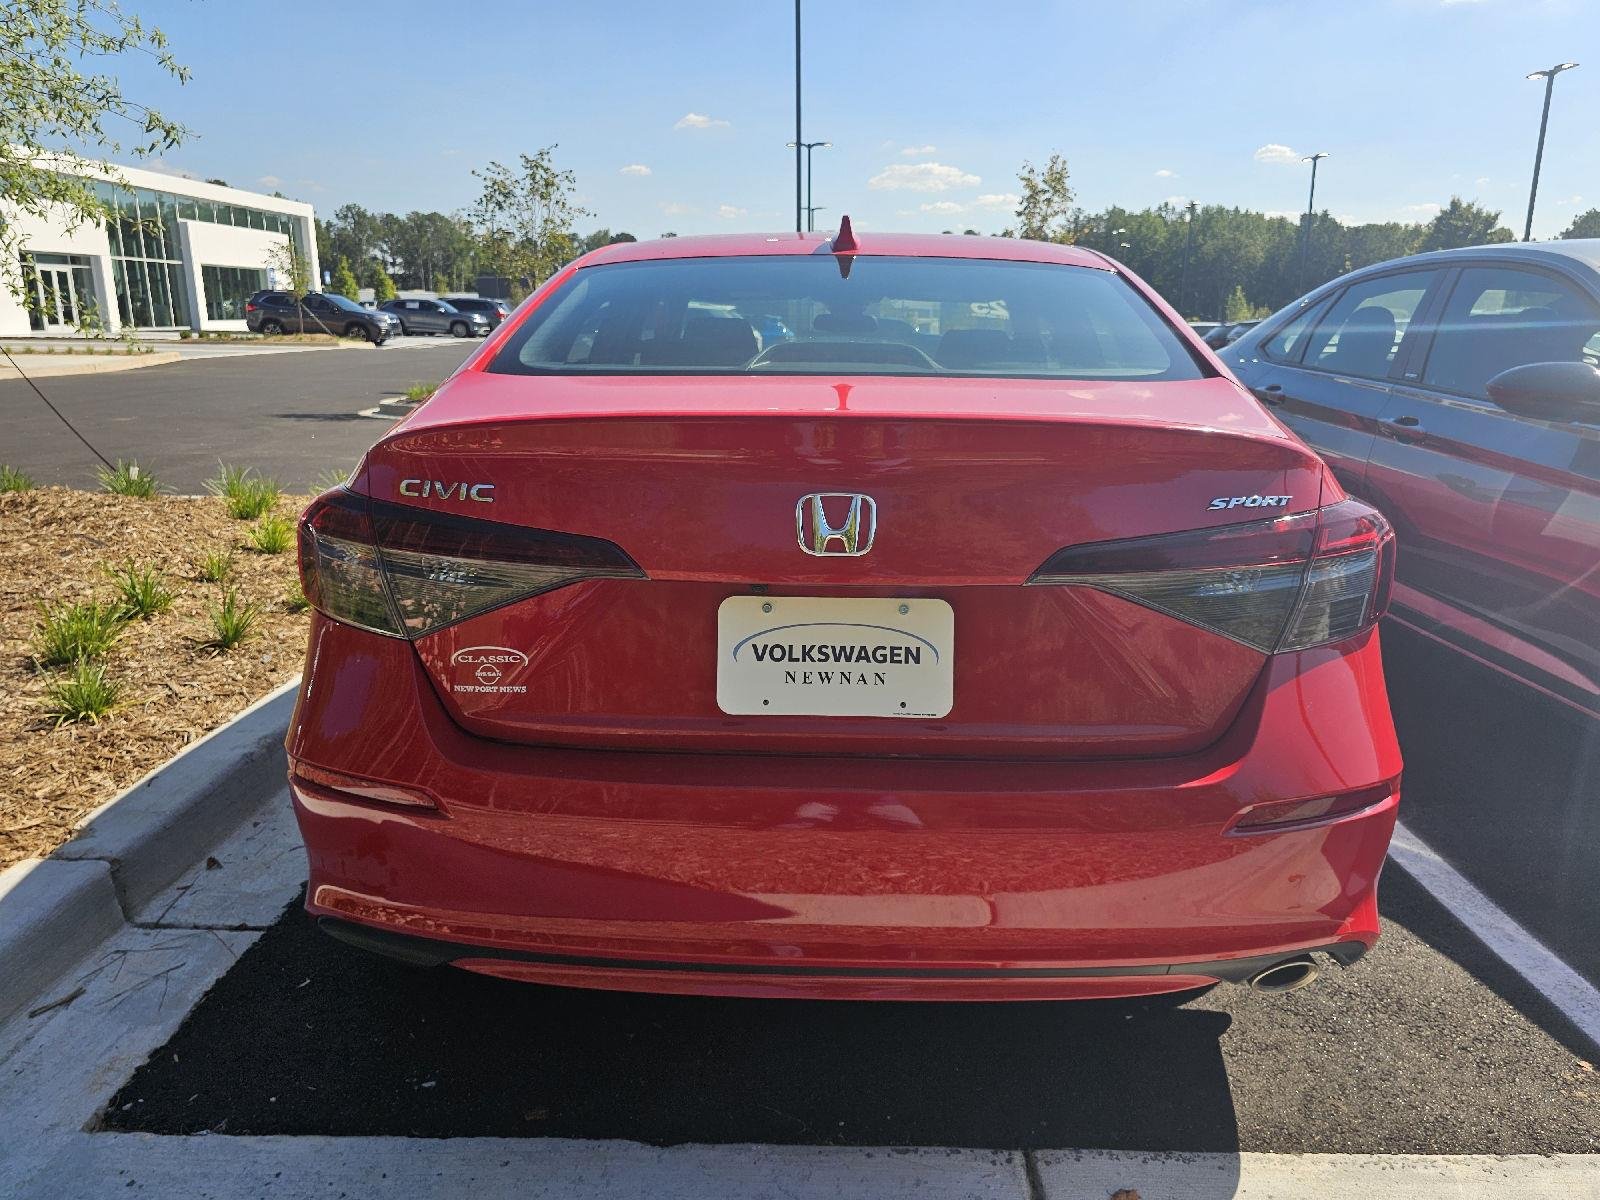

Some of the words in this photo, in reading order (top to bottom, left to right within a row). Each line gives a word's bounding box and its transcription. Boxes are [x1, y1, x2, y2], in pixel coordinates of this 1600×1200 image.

[400, 480, 495, 502] CIVIC
[1206, 495, 1293, 511] SPORT
[457, 655, 521, 664] CLASSIC
[752, 643, 921, 665] VOLKSWAGEN
[785, 670, 887, 686] NEWNAN
[454, 685, 499, 693] NEWPORT
[500, 686, 527, 694] NEWS
